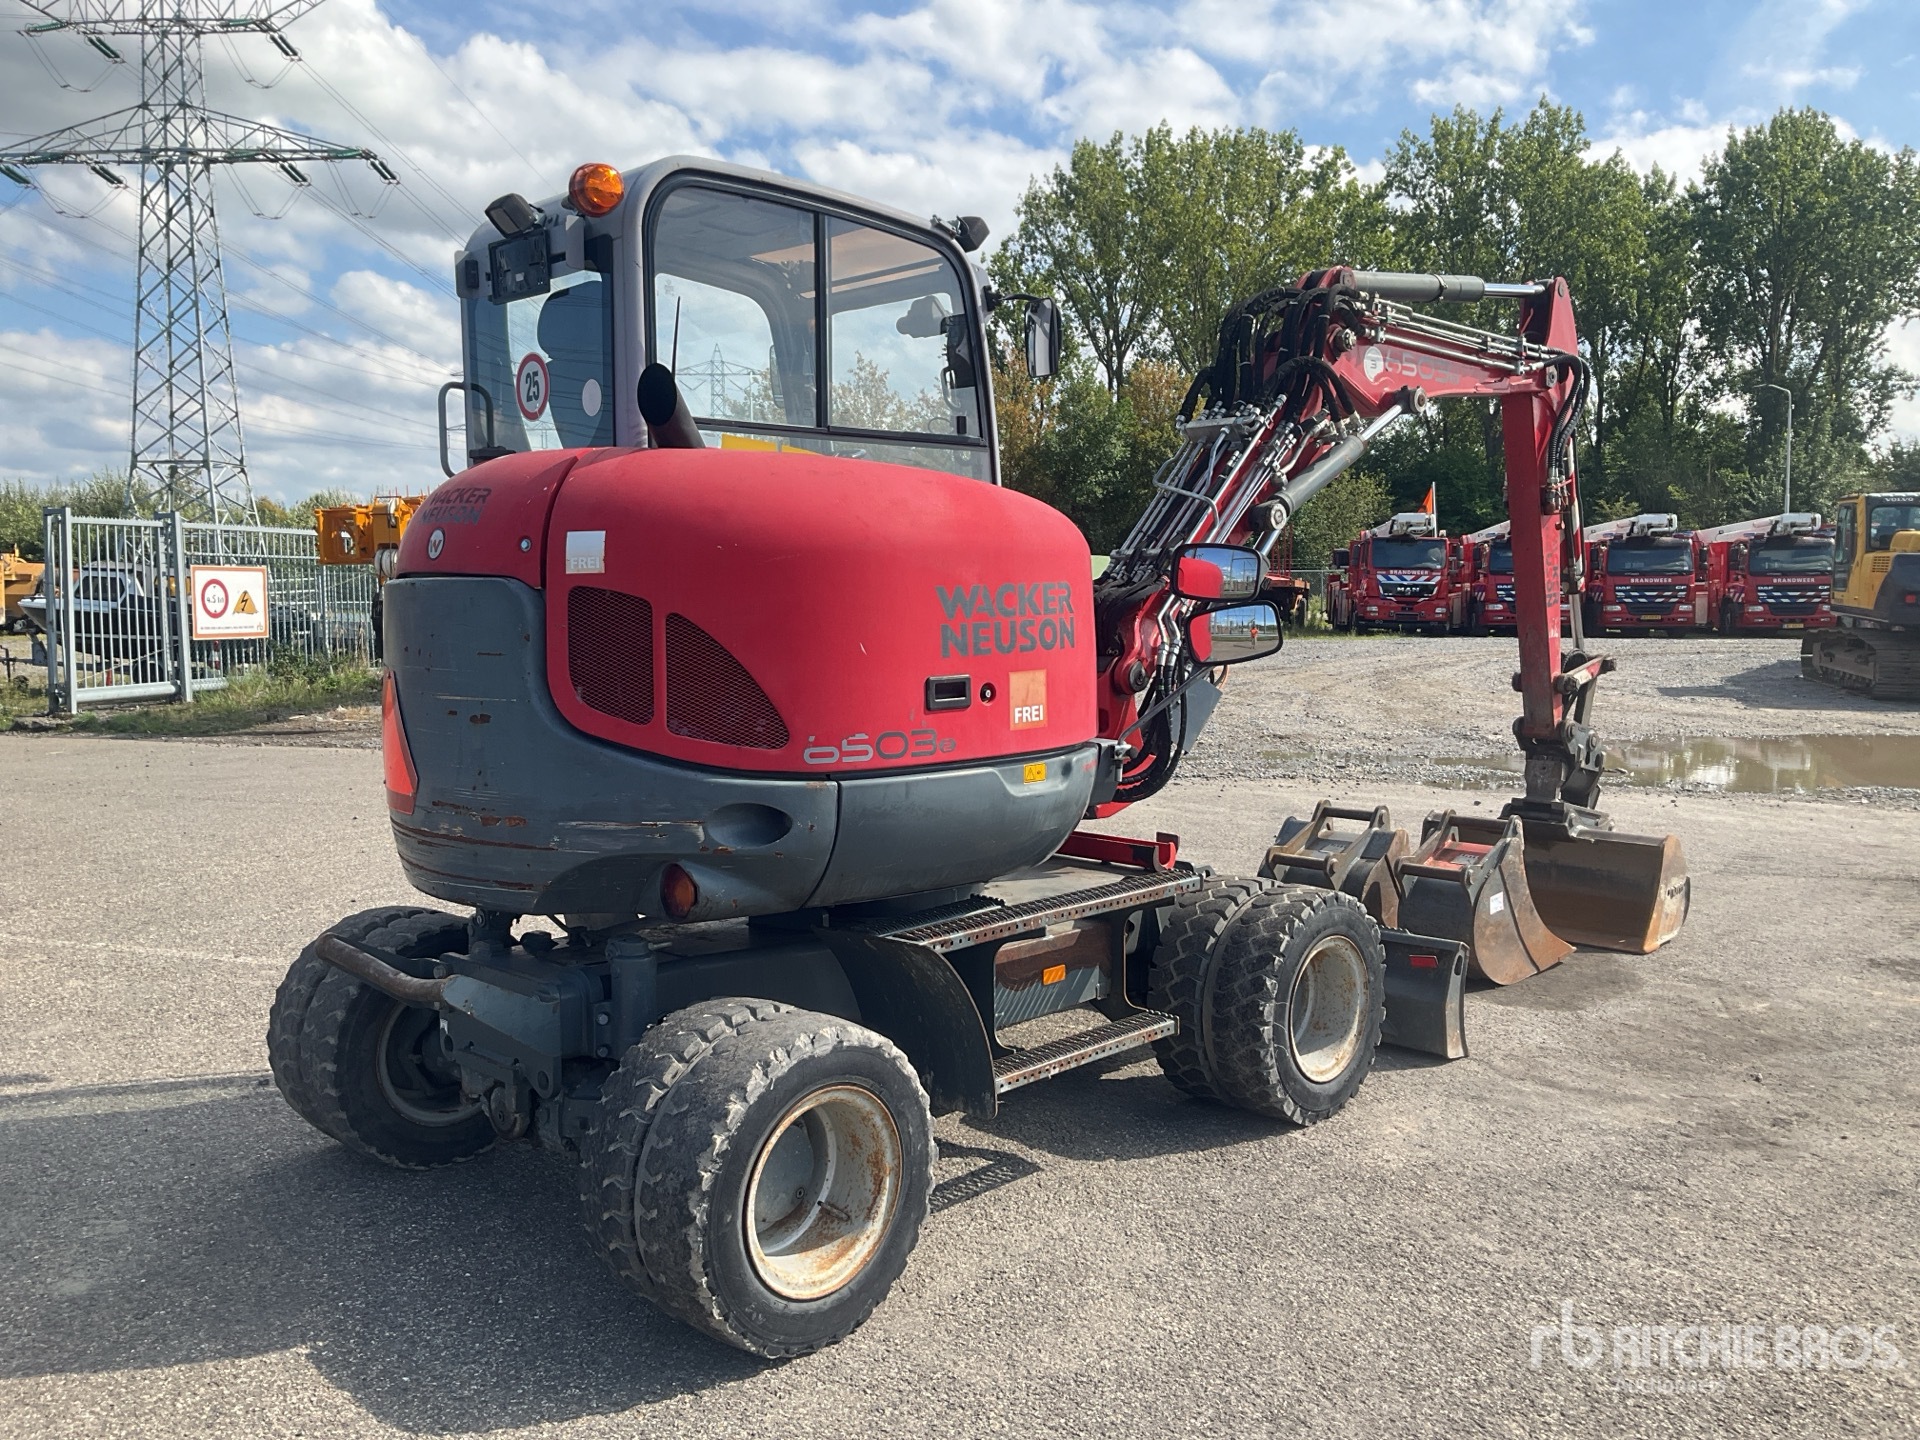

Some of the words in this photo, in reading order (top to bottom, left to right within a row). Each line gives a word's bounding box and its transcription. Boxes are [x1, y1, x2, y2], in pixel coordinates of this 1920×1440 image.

[525, 370, 540, 402] 25
[430, 487, 492, 506] WACKER
[421, 505, 484, 526] NEUSON
[570, 556, 600, 569] FREI
[935, 582, 1074, 620] WACKER
[940, 616, 1075, 659] NEUSON
[1014, 705, 1044, 724] FREI
